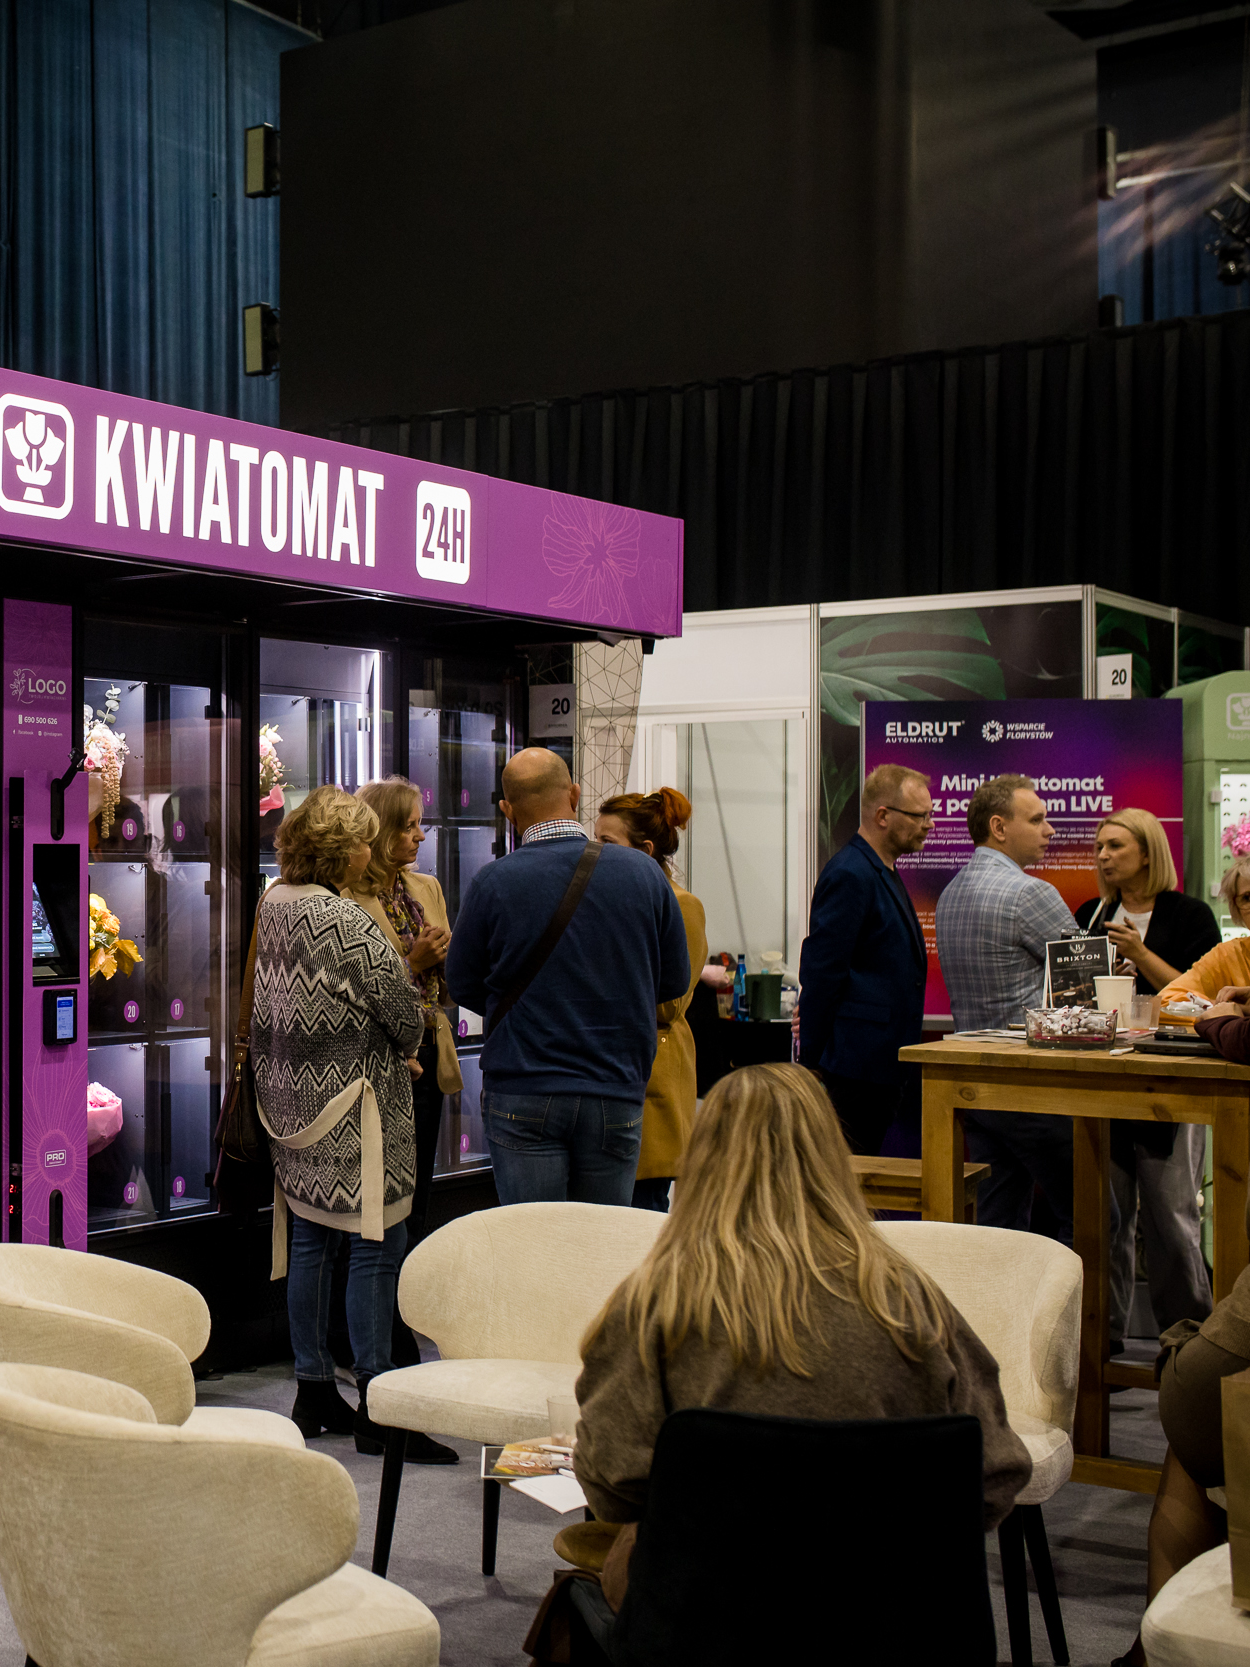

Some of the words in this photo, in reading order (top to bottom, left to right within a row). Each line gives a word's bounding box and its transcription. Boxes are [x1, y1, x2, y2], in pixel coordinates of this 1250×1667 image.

[95, 414, 384, 567] KWIATOMAT
[422, 502, 465, 564] 24H
[1112, 668, 1127, 686] 20
[28, 677, 67, 695] LOGO
[551, 697, 570, 715] 20
[24, 716, 35, 724] 690
[47, 717, 58, 725] 626
[1006, 723, 1046, 731] WSPARCIE
[886, 721, 961, 736] ELDRUT
[886, 736, 944, 744] AUTOMATICS
[426, 791, 431, 802] 5
[1070, 795, 1113, 812] LIVE
[126, 823, 134, 836] 19
[1056, 953, 1100, 963] BRIXTON
[127, 1005, 136, 1018] 20
[174, 1003, 180, 1016] 17
[46, 1152, 65, 1162] PRO
[127, 1186, 135, 1199] 21
